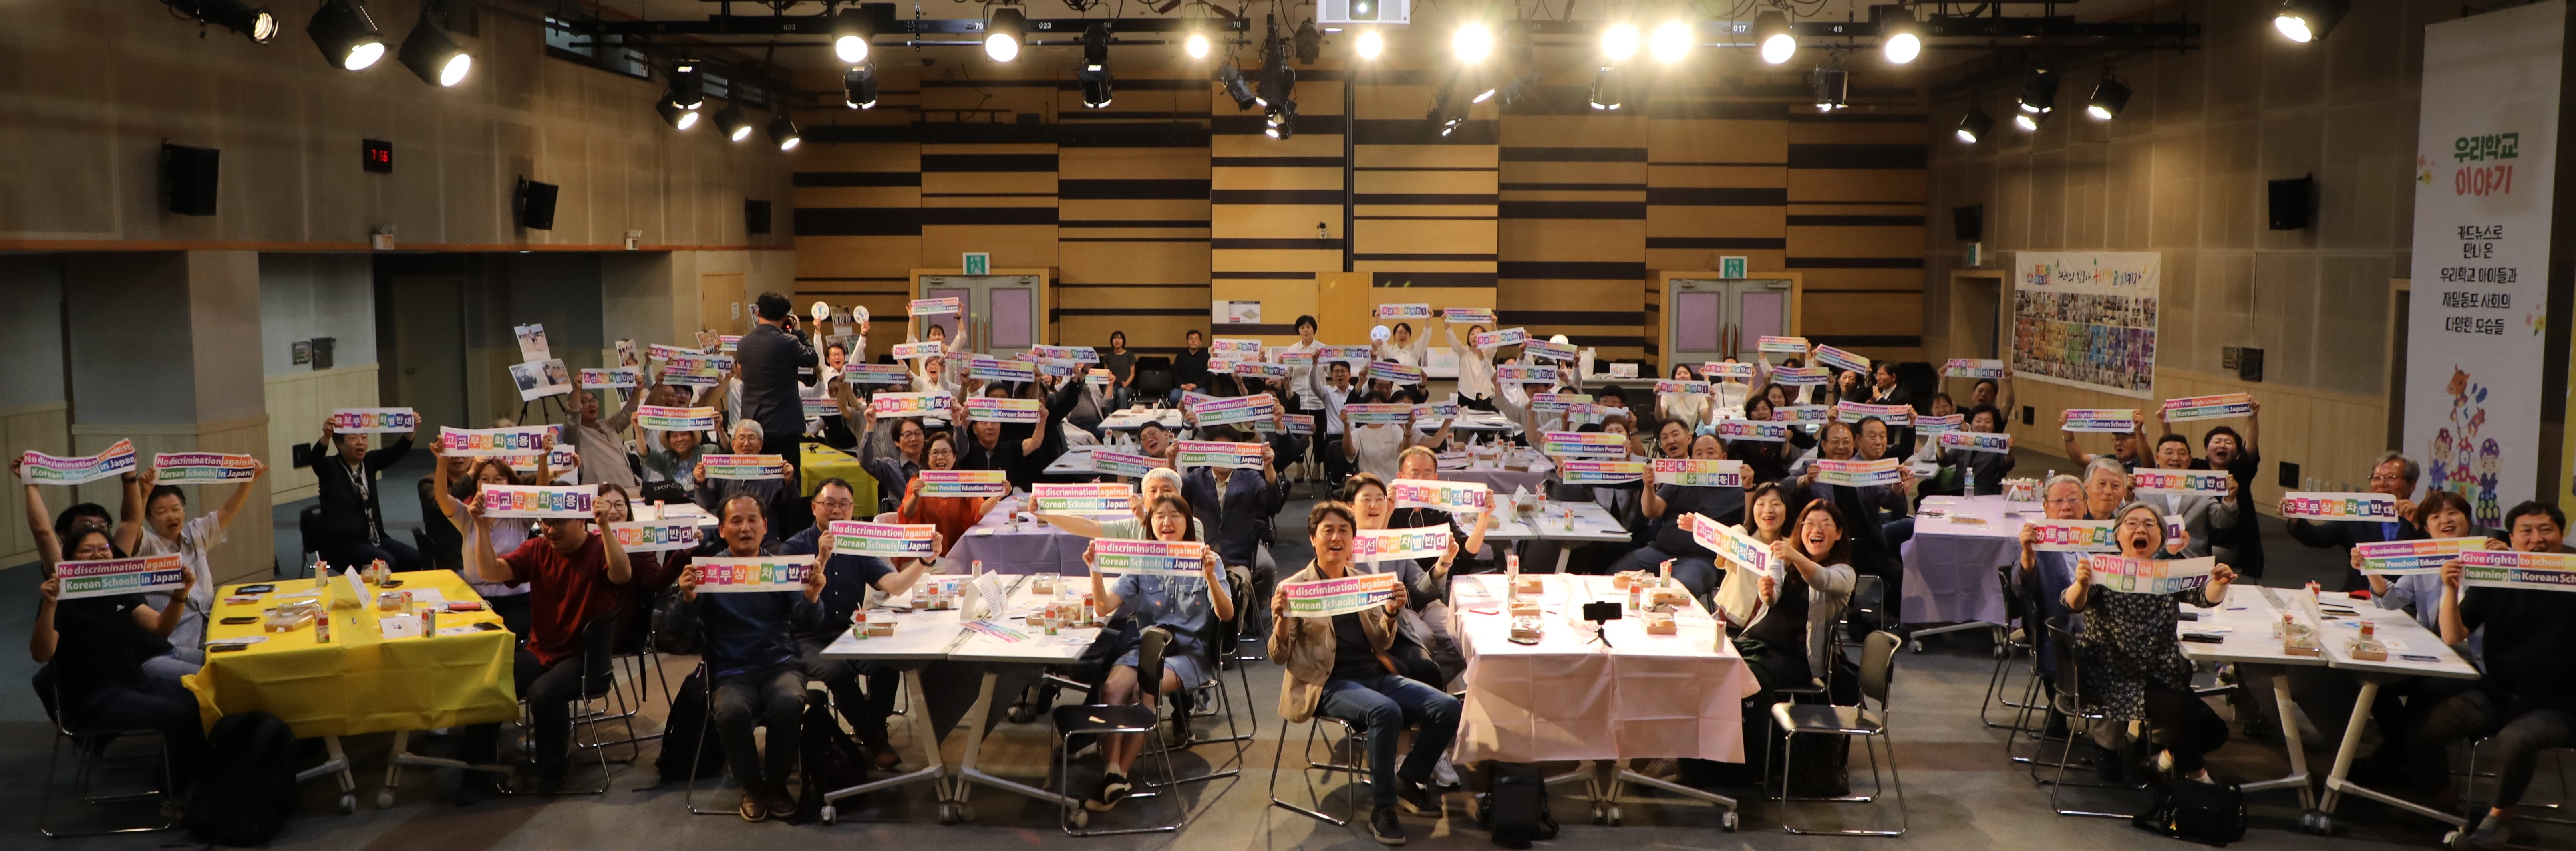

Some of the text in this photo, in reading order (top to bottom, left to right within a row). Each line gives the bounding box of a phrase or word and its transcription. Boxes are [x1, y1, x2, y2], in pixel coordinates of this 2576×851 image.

[2454, 133, 2518, 162] 우리학교
[2455, 165, 2512, 196] 이야기
[2458, 225, 2502, 240] 카드뉴스로
[2463, 243, 2493, 259] 만나 온
[2441, 267, 2517, 284] 우리학교 아이들과
[2443, 292, 2510, 309] 재일동포 사회의
[2445, 316, 2504, 335] 다양한 모습들
[1204, 400, 1247, 411] discrimination
[1249, 397, 1272, 406] against
[1847, 403, 1887, 413] discrimination
[2198, 407, 2221, 415] Schools
[2229, 405, 2250, 413] Japan!
[1200, 409, 1245, 421] Korean Schools
[1841, 411, 1862, 419] Korean
[445, 435, 539, 447] 고교무상화적용!
[1188, 444, 1235, 452] discrimination
[1237, 446, 1261, 454] against
[38, 455, 97, 469] discrimination
[157, 455, 254, 467] No discrimination against
[1097, 461, 1117, 470] Korean
[1103, 453, 1143, 465] discrimination
[1206, 454, 1231, 463] Schools
[1240, 456, 1262, 465] Japan!
[32, 467, 62, 479] Korean
[161, 468, 252, 478] Korean Schools Japan!
[1656, 461, 1717, 472] 子どもたち
[1829, 472, 1898, 481] Korean Japan!
[939, 484, 960, 492] Preschool
[1035, 487, 1128, 497] No discrimination against
[487, 493, 587, 509] 고교무상화적용!
[1397, 487, 1481, 505] 고교무상화적용!
[1040, 500, 1105, 508] Korean Schools in
[2286, 501, 2394, 515] 유보무상화차별반대
[614, 528, 693, 542] 학교차별반대
[833, 524, 932, 538] No discrimination against
[2036, 528, 2114, 543] 幼保無償化差別
[837, 538, 907, 551] Korean Schools in
[1095, 542, 1199, 556] No discrimination against
[1355, 534, 1446, 553] 조선학교차별반대
[1697, 523, 1763, 567] 고교무상화적용!
[2370, 544, 2437, 555] discrimination against
[1099, 557, 1202, 570] Korean Schools in Japan!
[2386, 559, 2418, 568] Preschool
[2463, 553, 2563, 567] Give rights to school
[59, 559, 180, 576] No discrimination against
[65, 572, 182, 590] Korean Schools Japan!
[2466, 568, 2559, 582] learning in Korean
[1296, 577, 1393, 596] discrimination against
[1290, 596, 1367, 609] Korean Schools in
